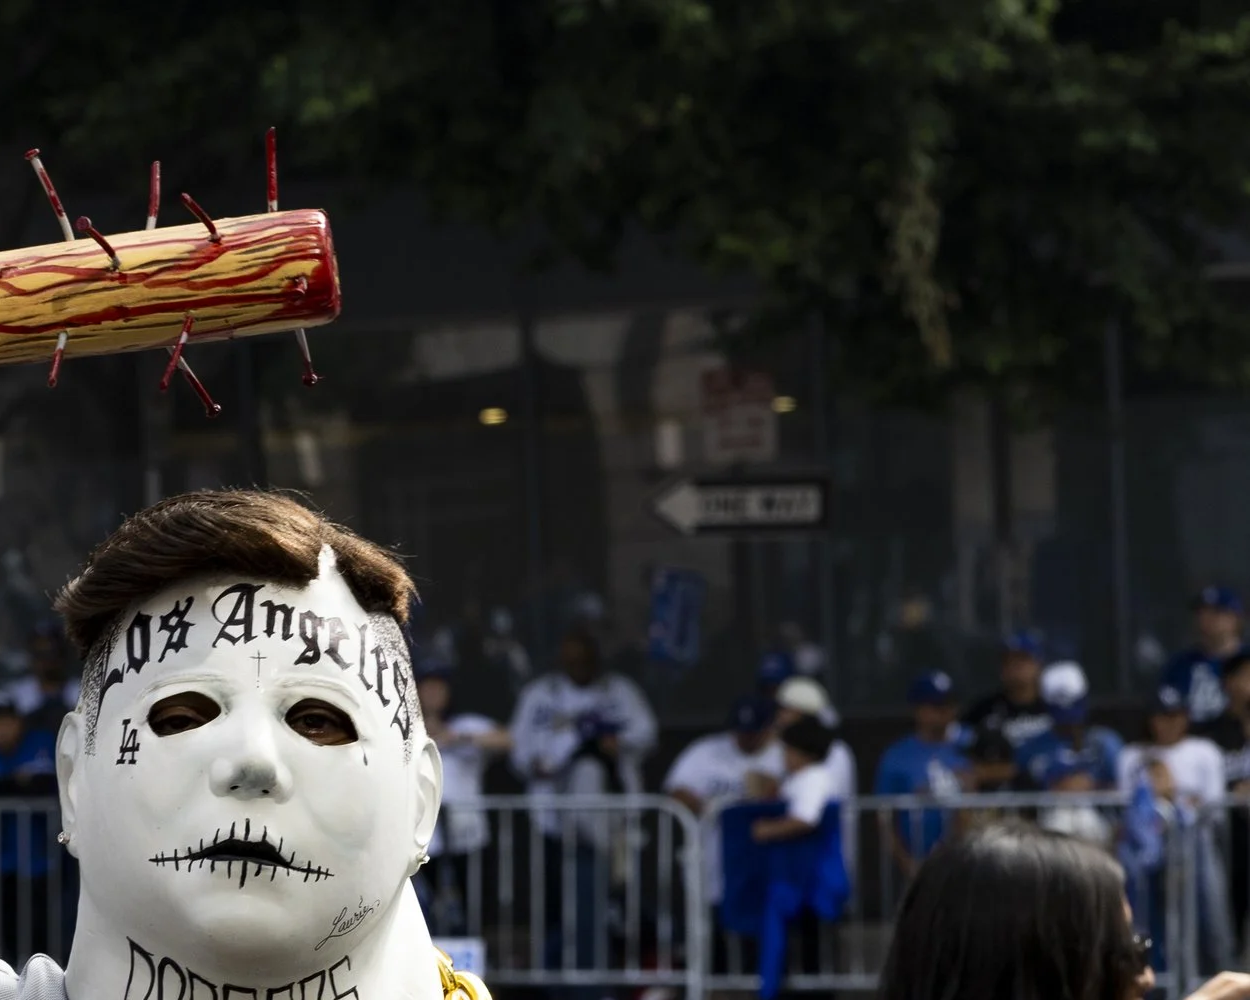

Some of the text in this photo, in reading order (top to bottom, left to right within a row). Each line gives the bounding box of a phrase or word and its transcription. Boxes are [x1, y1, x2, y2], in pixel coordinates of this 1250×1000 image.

[94, 583, 410, 741] Los Angeles
[116, 718, 140, 765] LA
